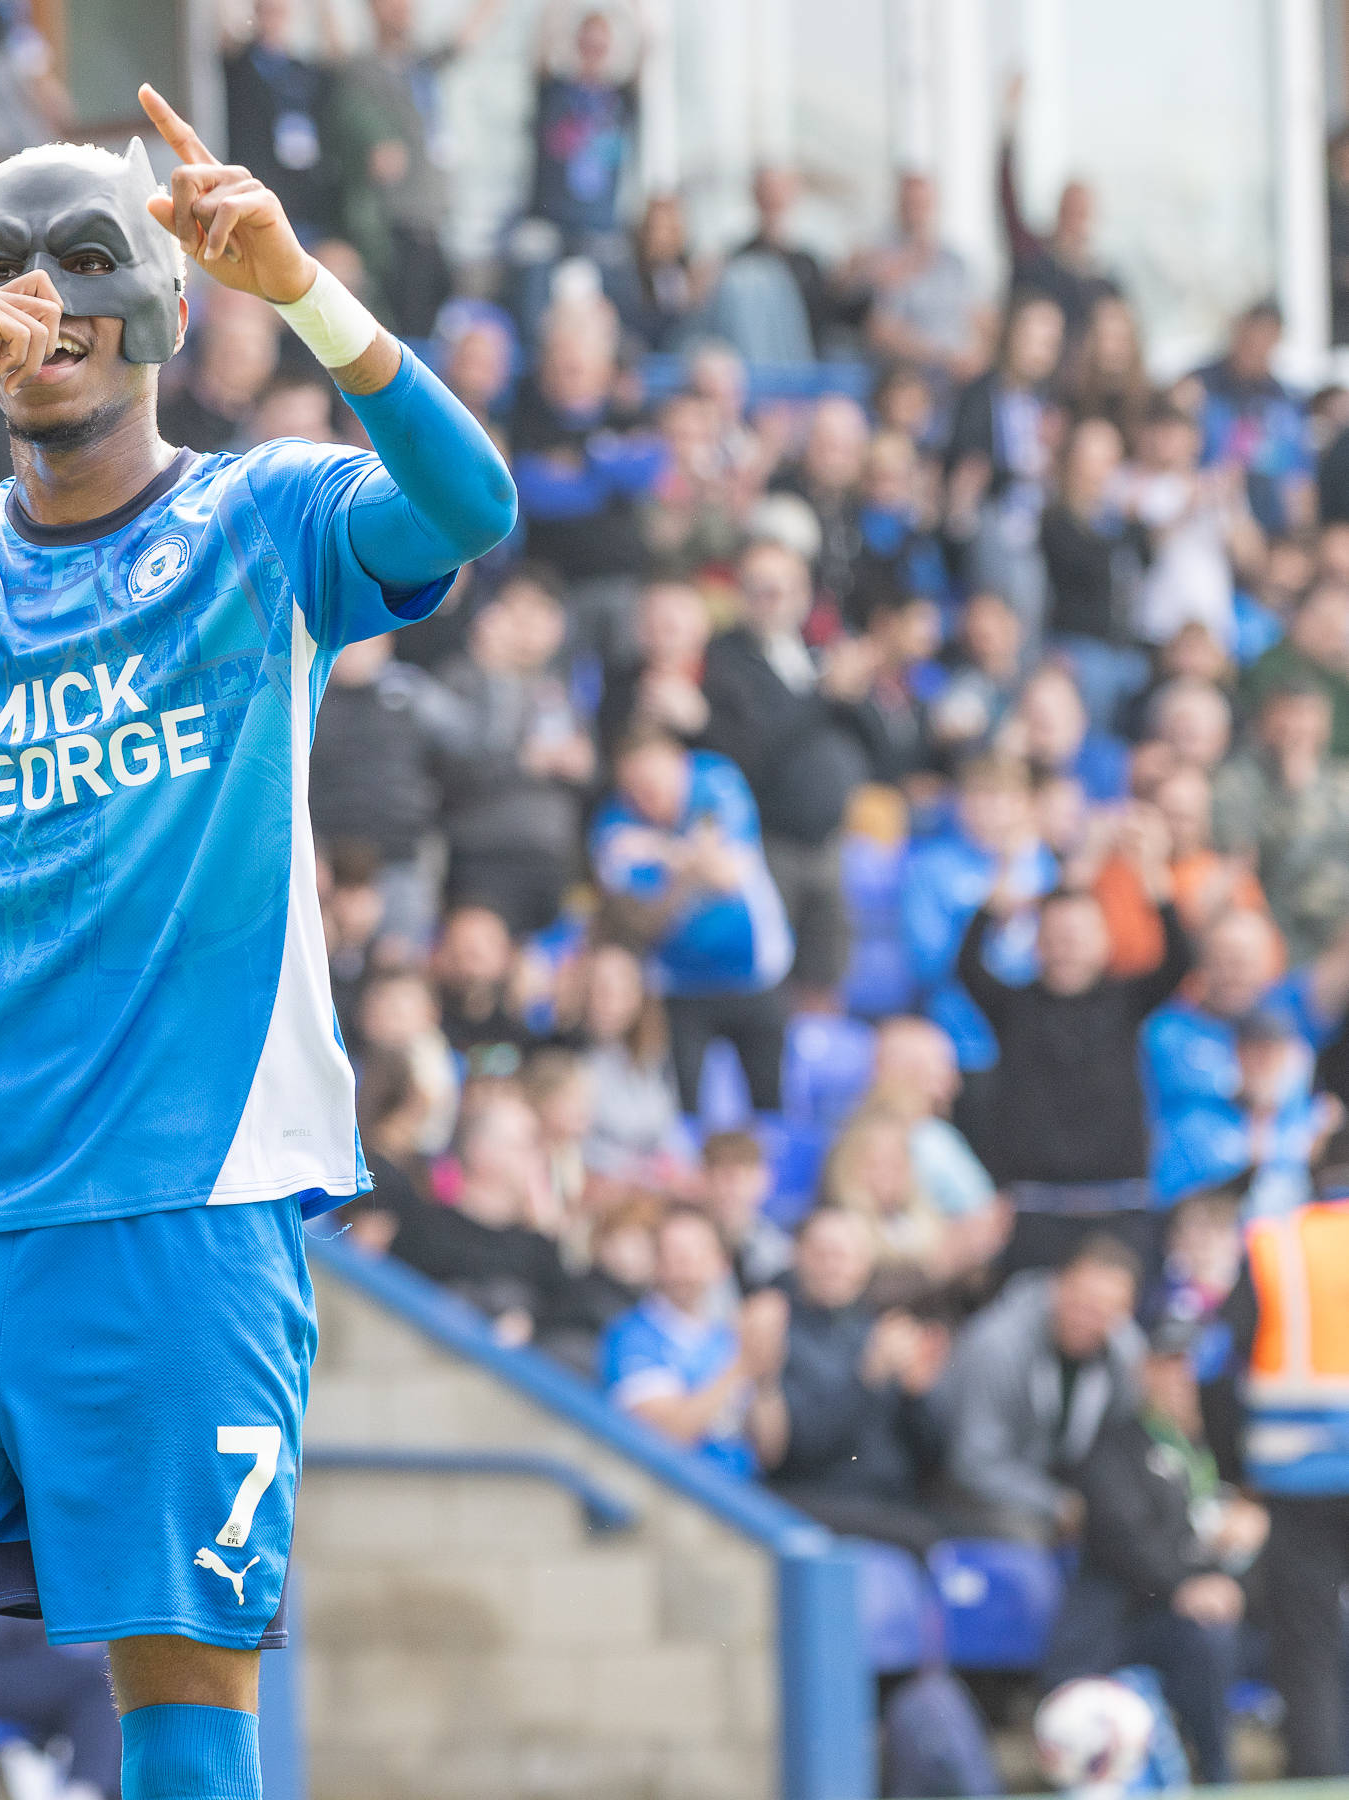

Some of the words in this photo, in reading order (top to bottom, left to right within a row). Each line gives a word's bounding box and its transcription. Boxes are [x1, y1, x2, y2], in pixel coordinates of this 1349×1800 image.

[282, 1128, 313, 1138] DRYCELL
[215, 1425, 282, 1547] 7
[227, 1537, 239, 1545] EFL
